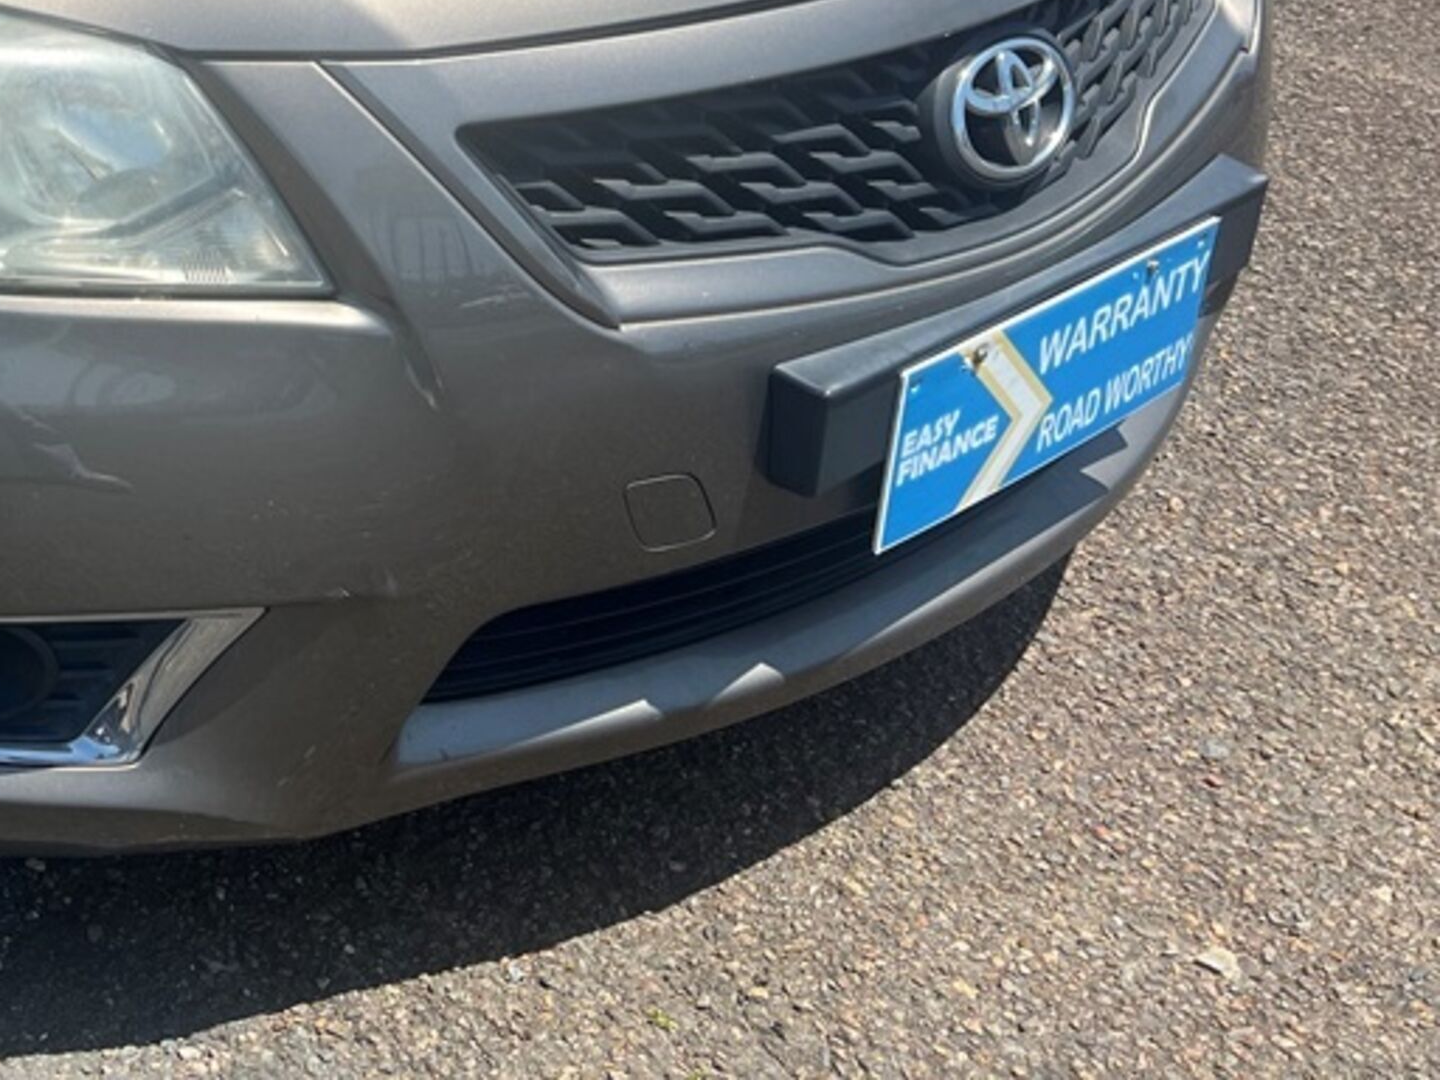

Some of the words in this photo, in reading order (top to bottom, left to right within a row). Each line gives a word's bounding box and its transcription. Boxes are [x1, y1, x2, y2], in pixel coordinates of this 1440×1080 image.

[1038, 248, 1211, 376] WARRANTY
[900, 408, 961, 460] EASY
[1036, 386, 1101, 453] ROAD
[1104, 331, 1194, 415] WORTHY
[896, 413, 1000, 488] FINANCE
